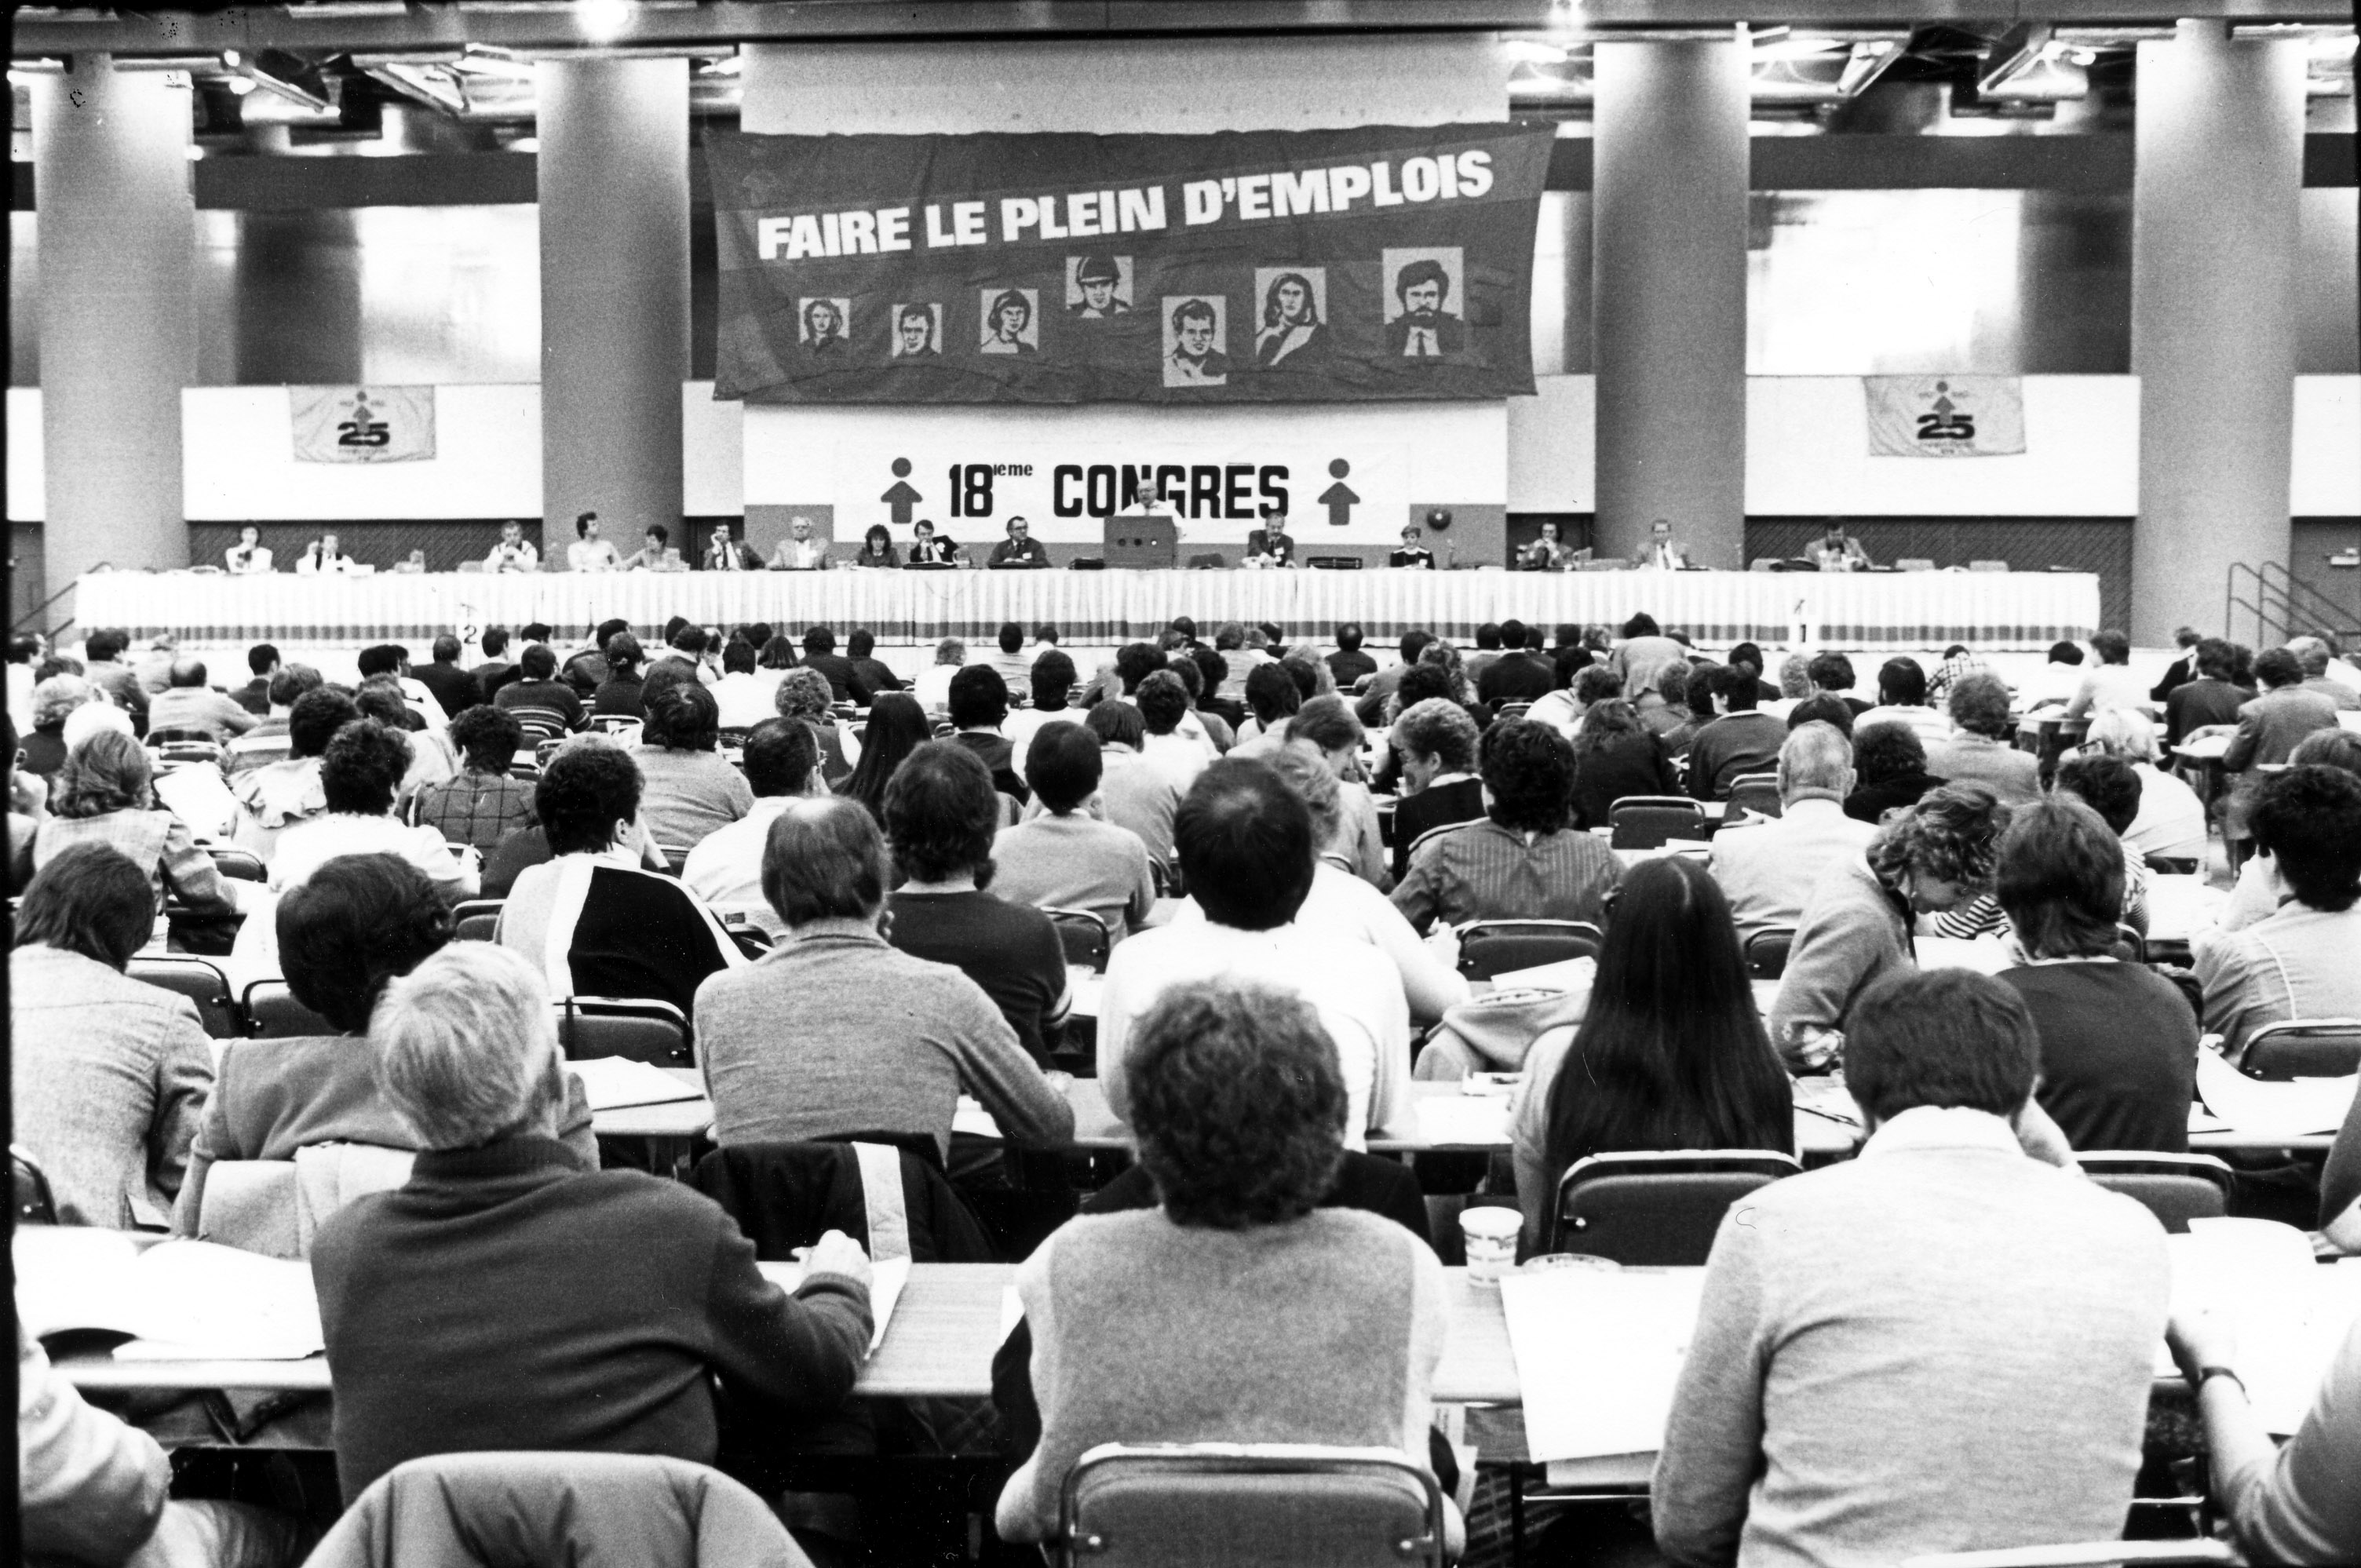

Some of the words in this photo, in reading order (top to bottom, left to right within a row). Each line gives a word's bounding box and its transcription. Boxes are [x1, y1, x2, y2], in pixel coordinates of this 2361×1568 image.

[757, 206, 912, 260] FAIRE
[925, 201, 987, 248] LE
[1000, 185, 1167, 242] PLEIN
[1183, 150, 1494, 226] D'EMPLOIS
[338, 421, 390, 447] 25
[1917, 414, 1975, 439] 25
[463, 625, 477, 644] 2
